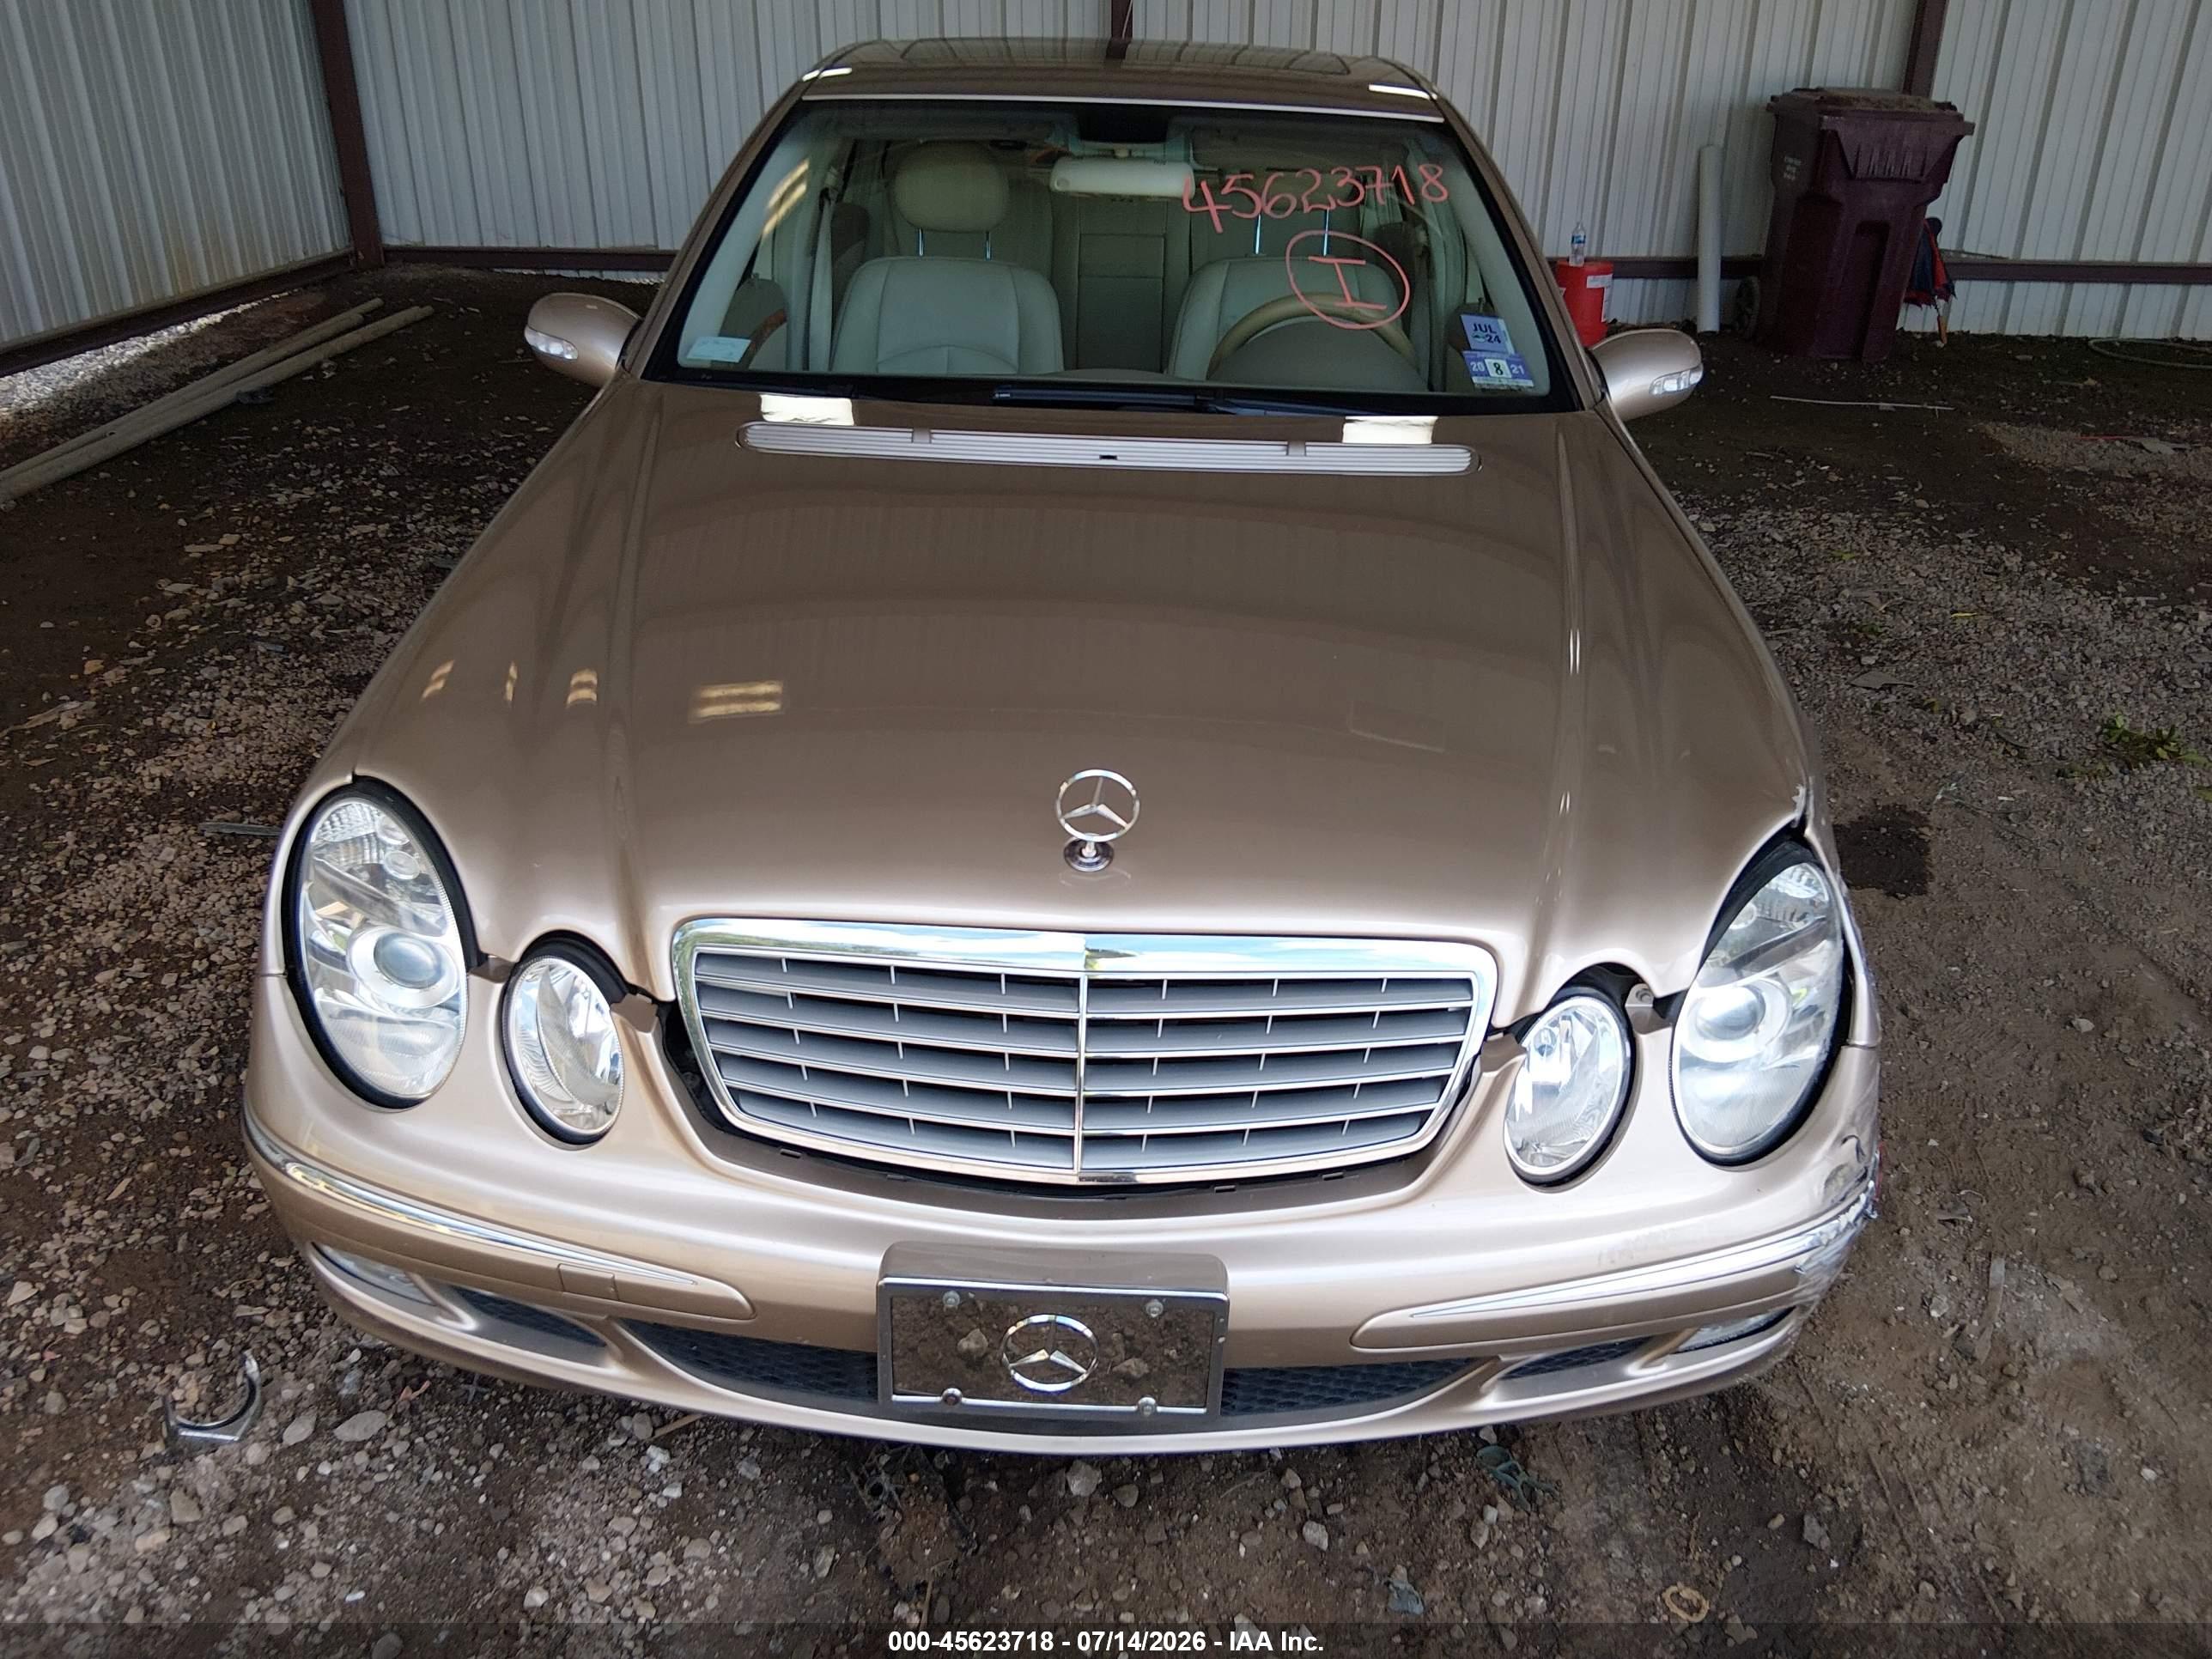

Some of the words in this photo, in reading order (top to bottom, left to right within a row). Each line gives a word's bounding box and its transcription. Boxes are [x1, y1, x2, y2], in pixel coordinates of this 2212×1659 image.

[1182, 164, 1449, 234] 45623718
[1473, 323, 1497, 334] JUL
[1485, 333, 1502, 344] 24
[1470, 361, 1486, 372] 20
[1492, 362, 1504, 375] 8
[1510, 364, 1525, 374] 21
